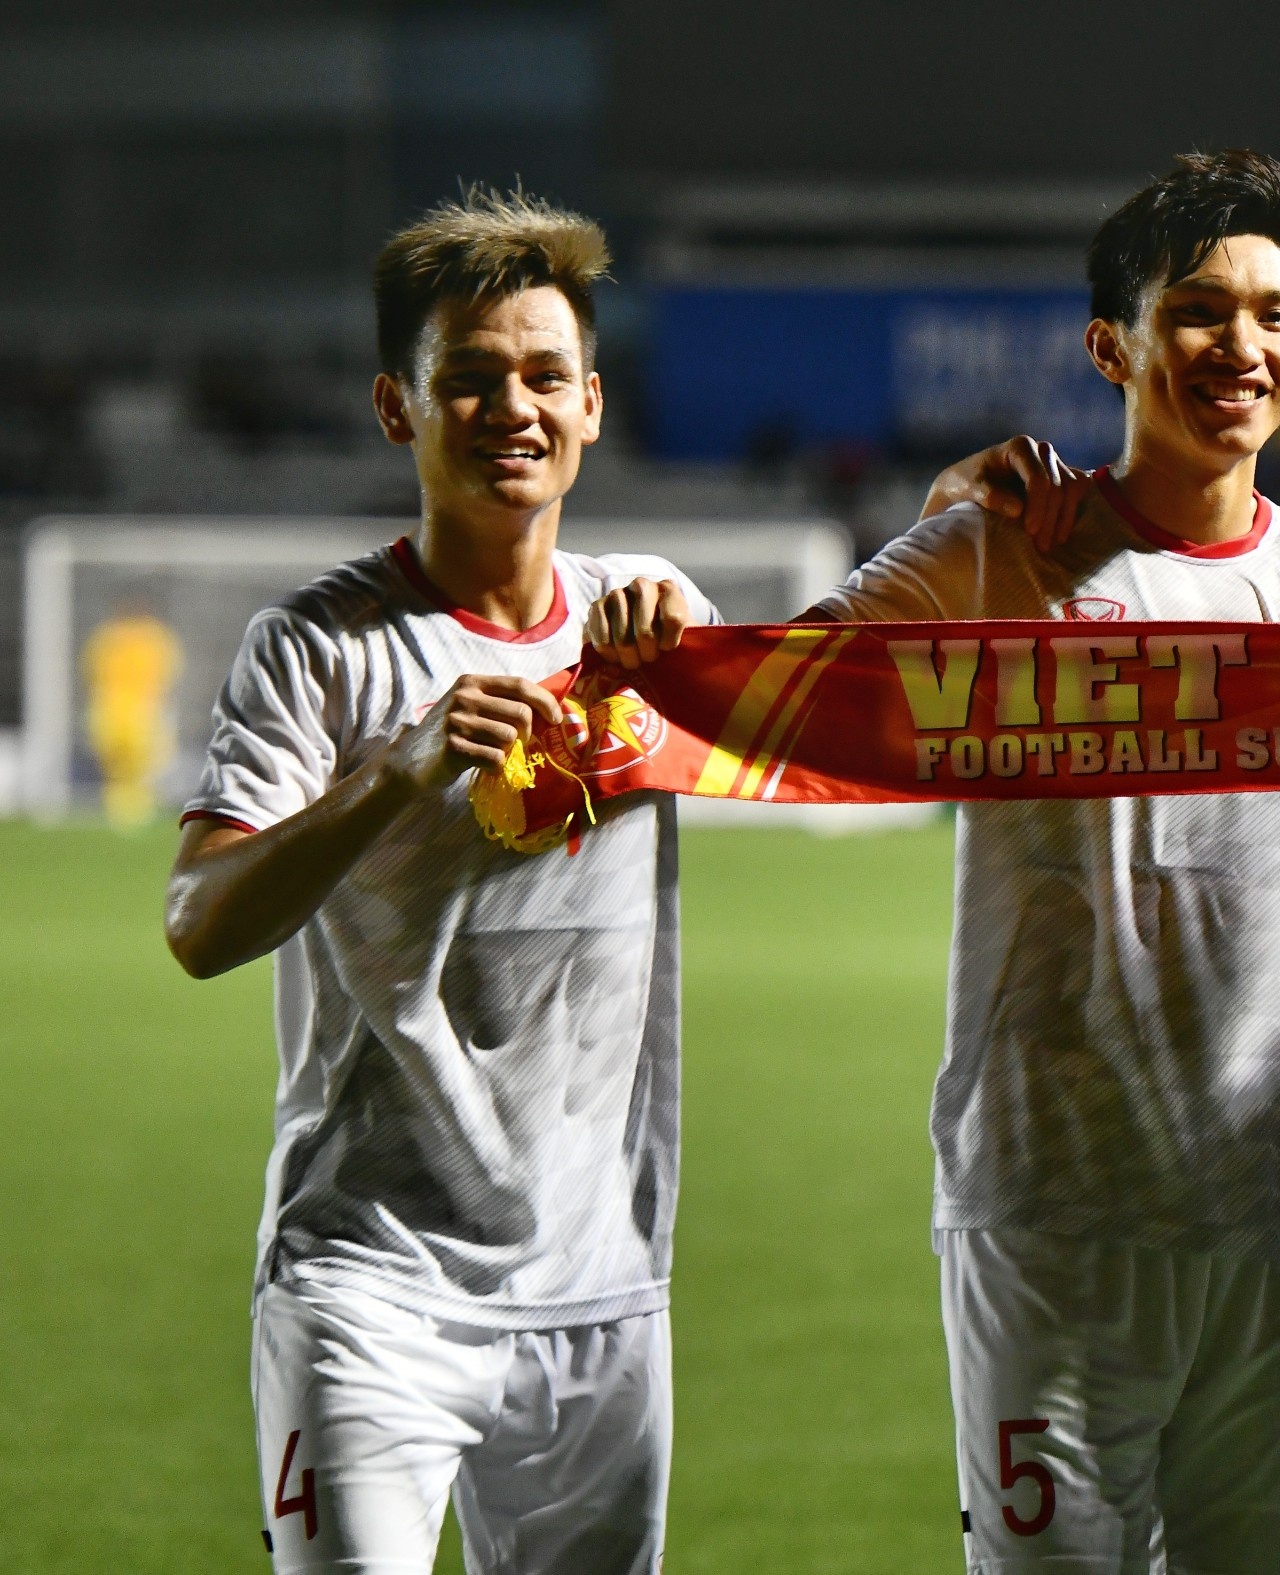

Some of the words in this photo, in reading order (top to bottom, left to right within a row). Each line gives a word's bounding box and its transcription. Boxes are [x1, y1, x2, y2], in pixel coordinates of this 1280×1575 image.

[887, 634, 1248, 730] VIET
[914, 728, 1217, 781] FOOTBALL
[274, 1429, 318, 1540] 4
[998, 1419, 1056, 1537] 5
